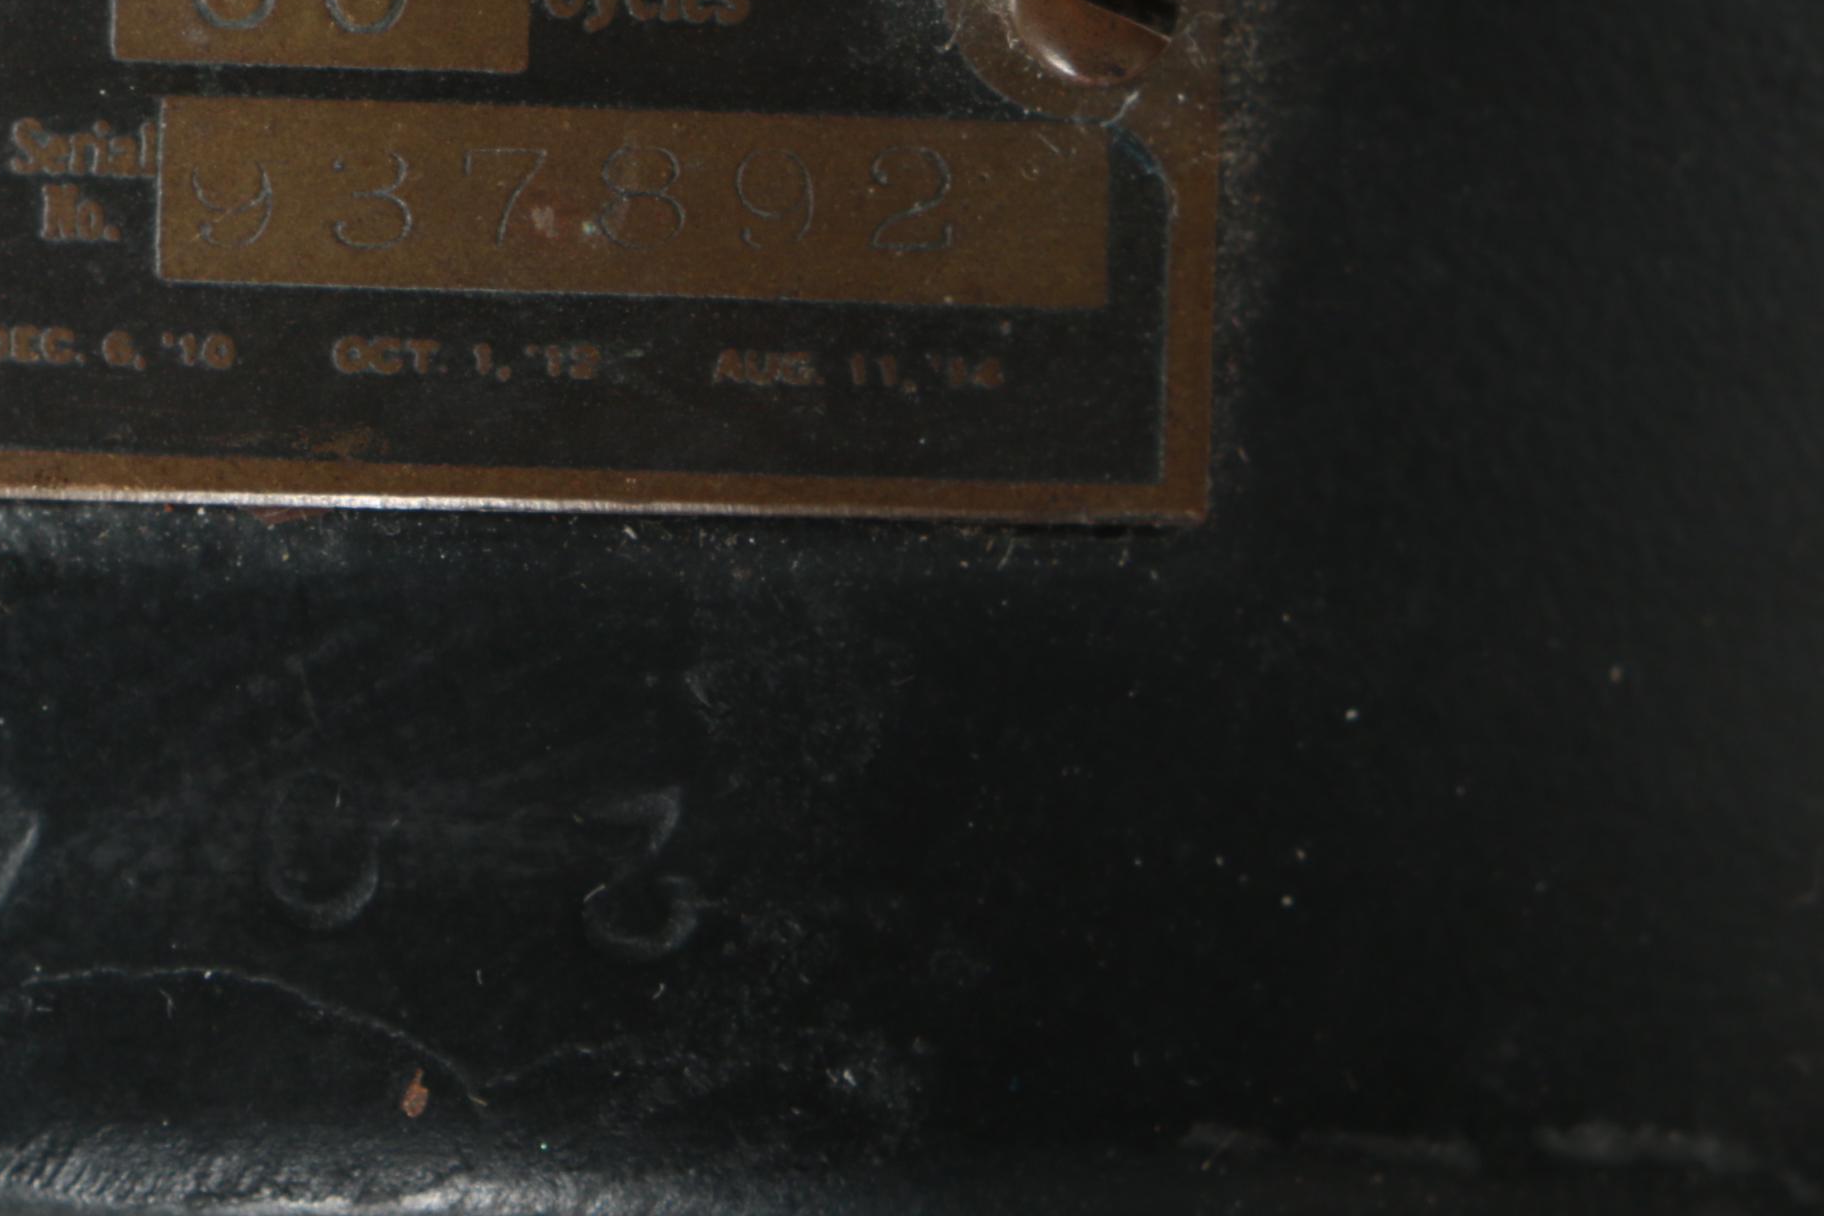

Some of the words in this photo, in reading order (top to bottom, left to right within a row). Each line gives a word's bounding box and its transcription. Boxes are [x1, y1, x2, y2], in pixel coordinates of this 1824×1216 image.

[9, 116, 158, 180] Serial
[39, 182, 122, 244] No.
[190, 145, 955, 253] 937892
